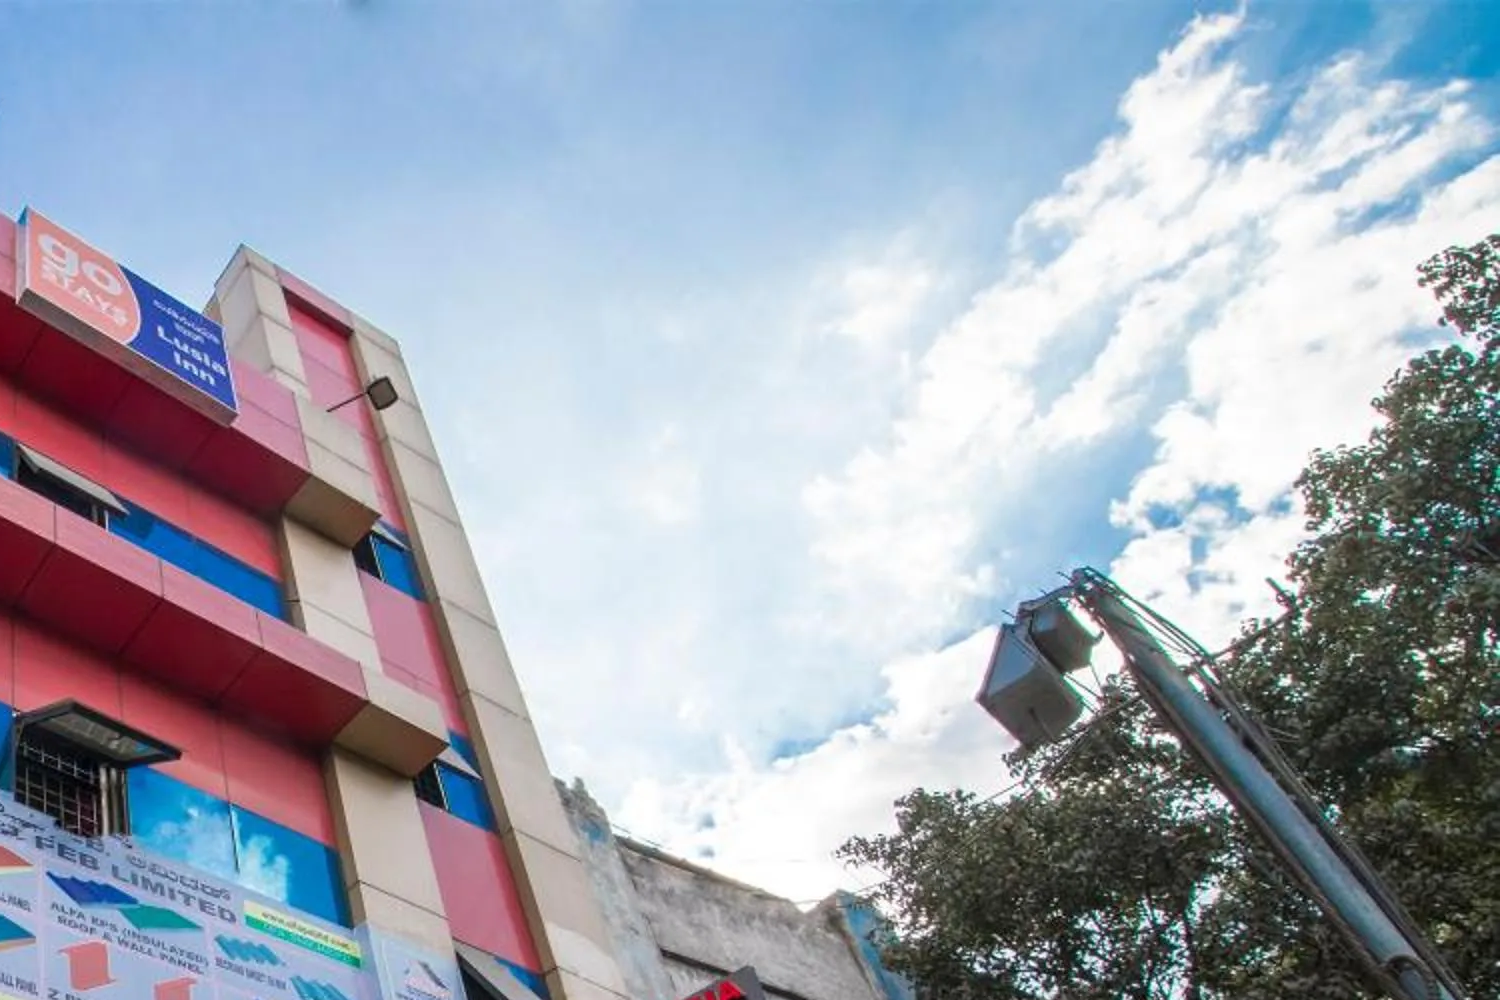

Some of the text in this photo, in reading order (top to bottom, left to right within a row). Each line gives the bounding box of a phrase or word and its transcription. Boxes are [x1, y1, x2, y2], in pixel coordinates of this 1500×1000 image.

[173, 351, 216, 387] Inn
[111, 863, 237, 923] LIMITED
[51, 902, 87, 921] ALFA
